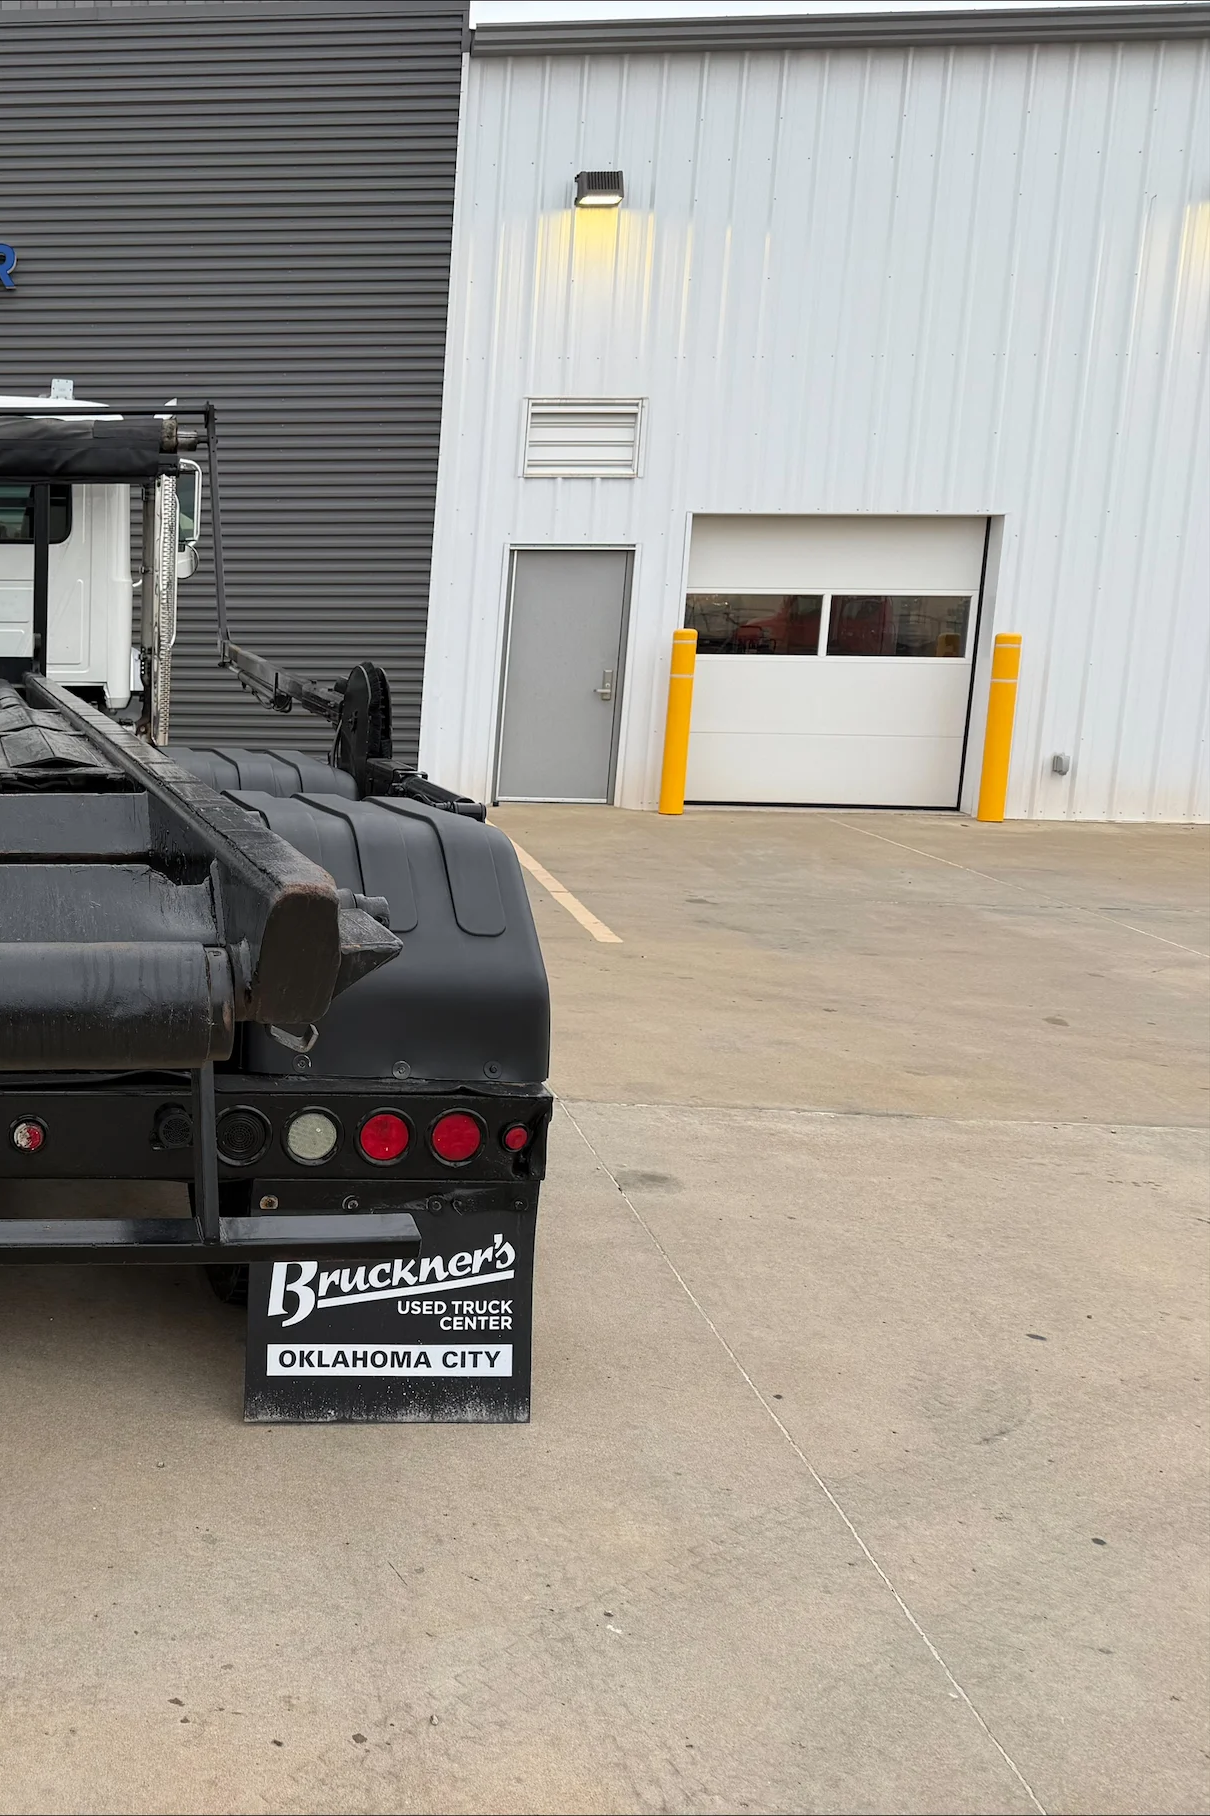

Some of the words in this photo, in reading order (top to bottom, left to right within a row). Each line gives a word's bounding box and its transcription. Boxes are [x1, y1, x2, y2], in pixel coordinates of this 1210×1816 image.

[267, 1233, 516, 1328] Bruckner's
[397, 1300, 446, 1315] USED
[451, 1300, 513, 1314] TRUCK
[440, 1316, 513, 1331] CENTER
[279, 1350, 432, 1368] OKLAHOMA
[442, 1350, 501, 1368] CITY
